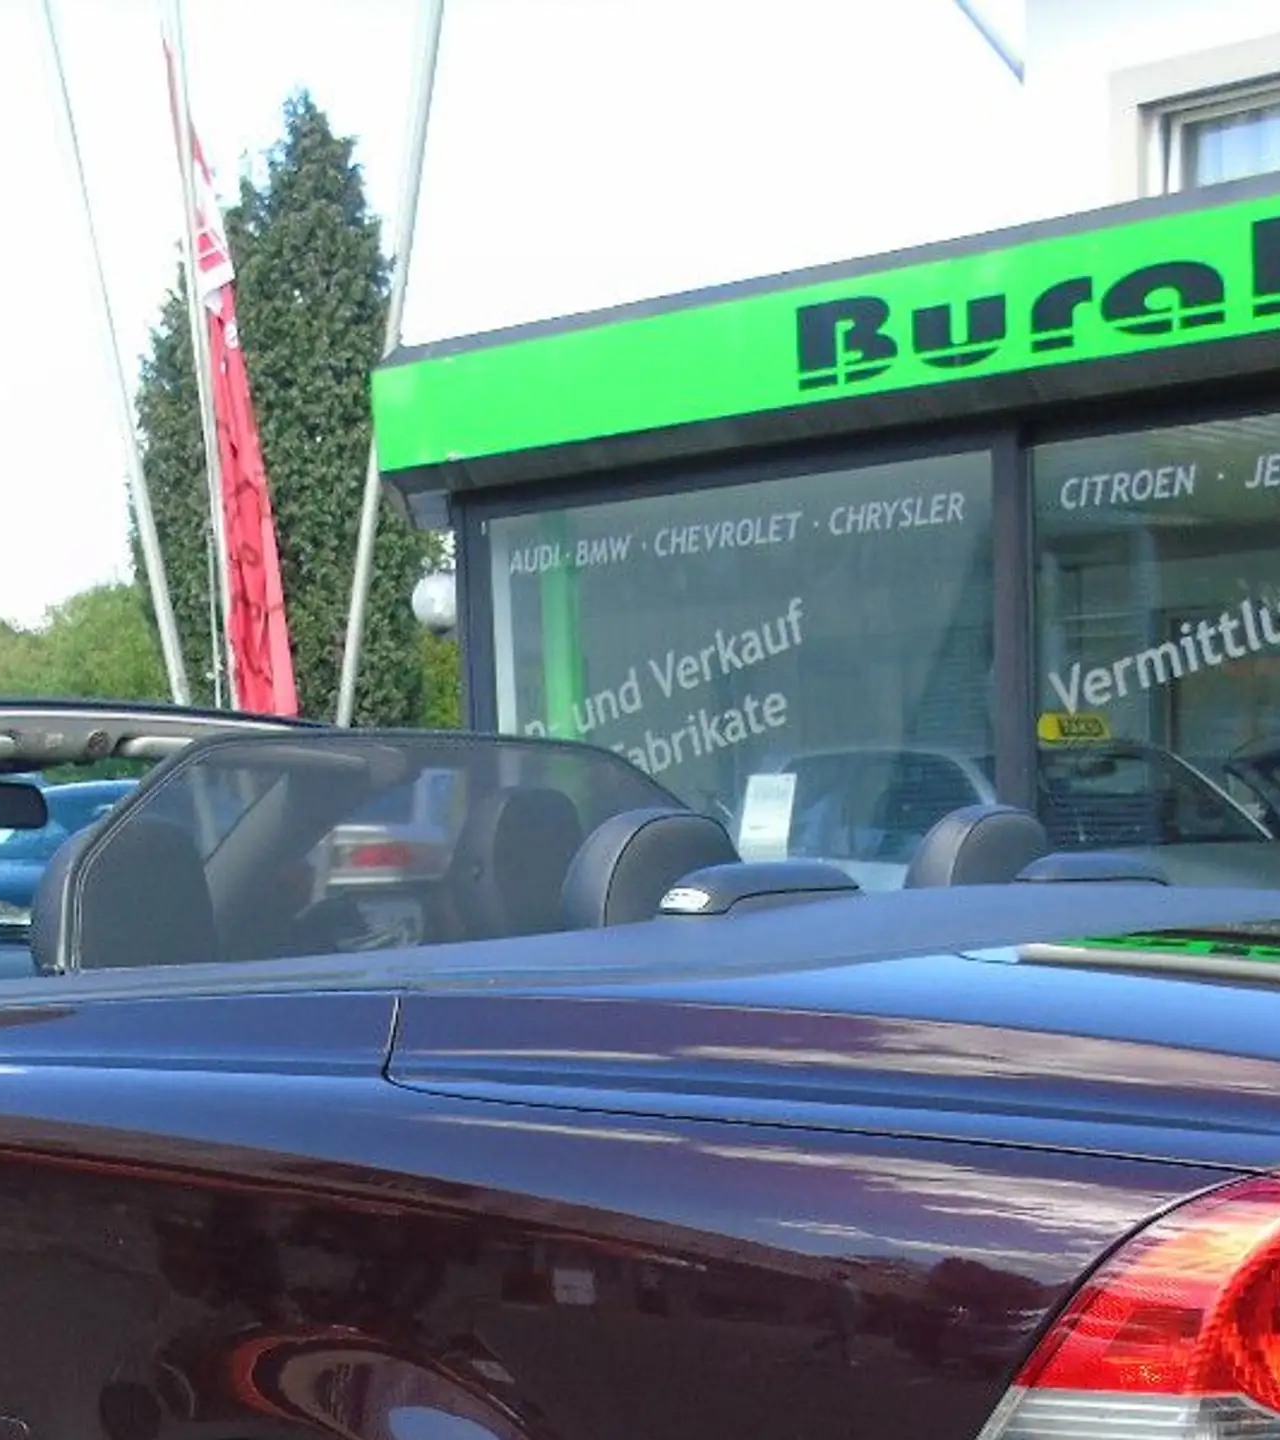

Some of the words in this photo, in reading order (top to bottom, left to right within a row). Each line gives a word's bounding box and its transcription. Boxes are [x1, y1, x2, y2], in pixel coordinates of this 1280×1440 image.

[1059, 464, 1197, 511] CITROEN
[508, 543, 562, 575] AUDI
[574, 533, 632, 568] BMW
[653, 510, 805, 558] CHEVROLET
[827, 491, 966, 536] CHRYSLER
[572, 665, 644, 734] und
[648, 596, 806, 699] Verkauf
[608, 691, 789, 776] abrikate
